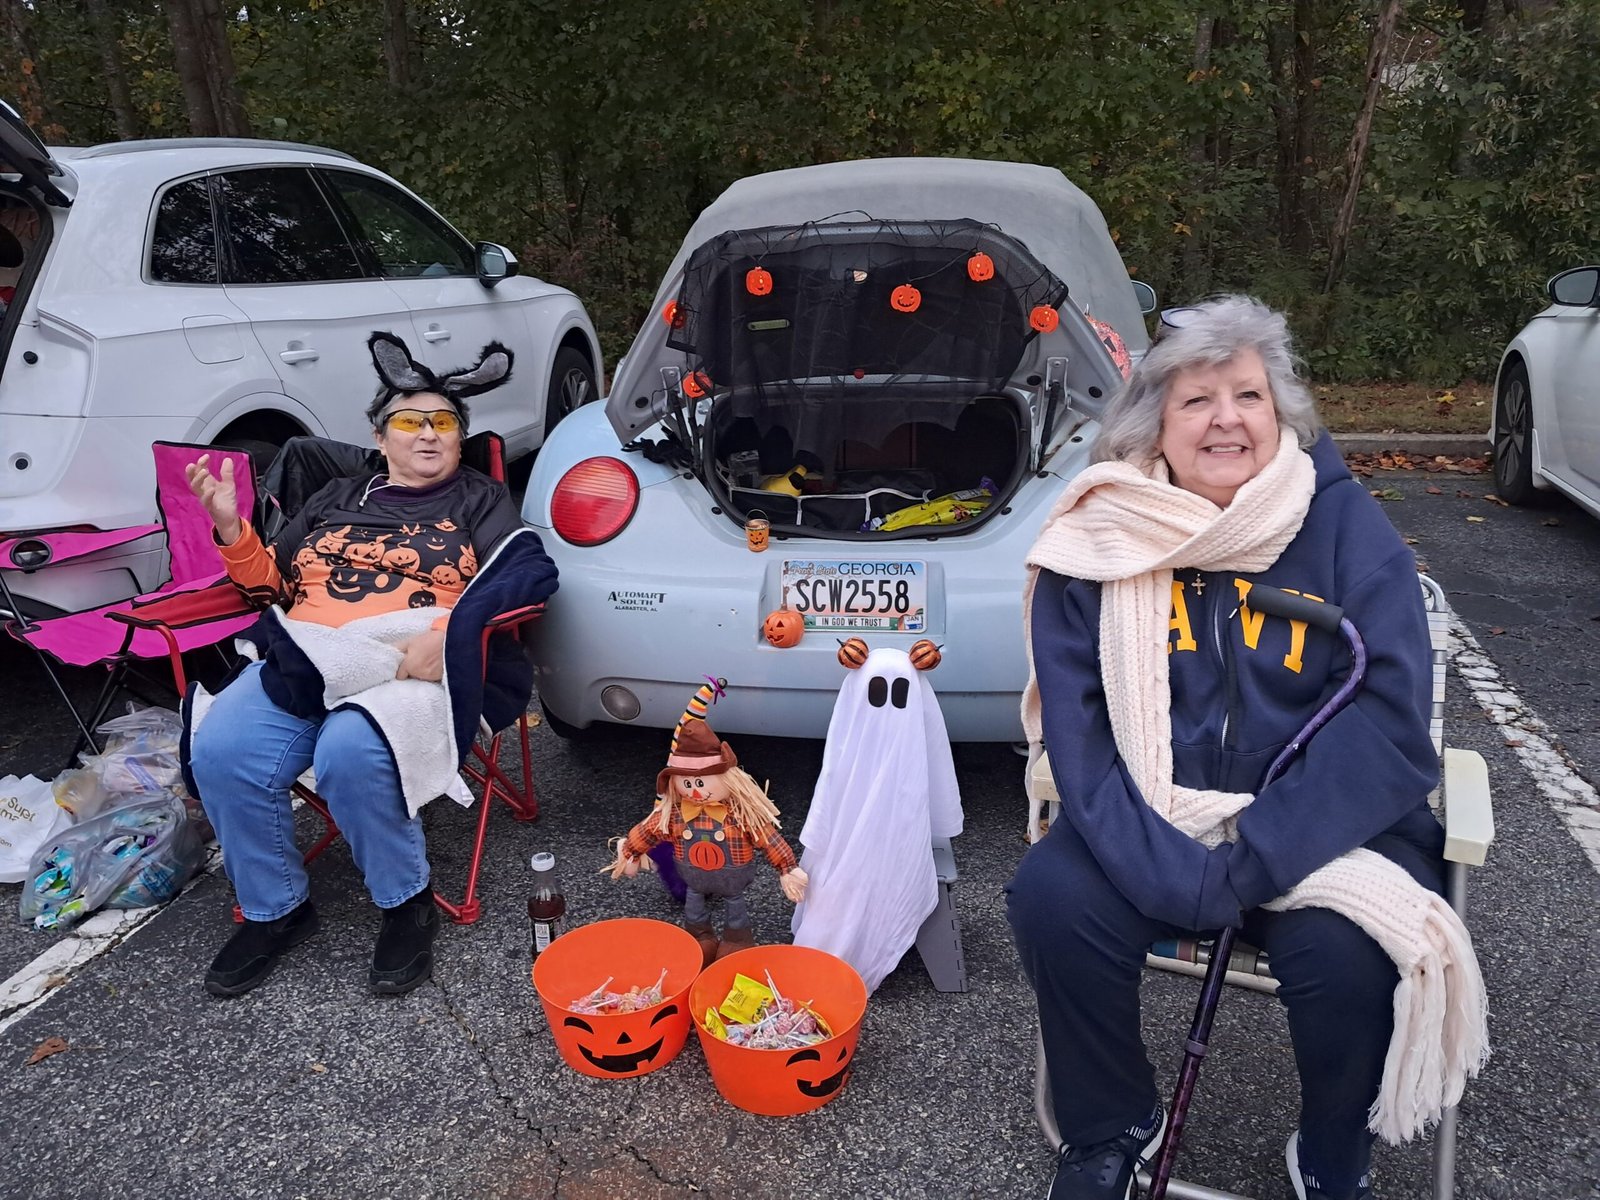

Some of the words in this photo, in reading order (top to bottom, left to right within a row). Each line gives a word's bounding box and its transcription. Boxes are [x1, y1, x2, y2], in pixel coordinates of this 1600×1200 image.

[837, 562, 916, 576] GEORGIA
[608, 591, 667, 603] AUTOMART
[795, 578, 910, 614] SCW2558
[821, 617, 830, 627] IN
[831, 617, 846, 627] GOD
[848, 618, 859, 627] WE
[861, 618, 882, 627] TRUST
[1167, 577, 1326, 674] AVY
